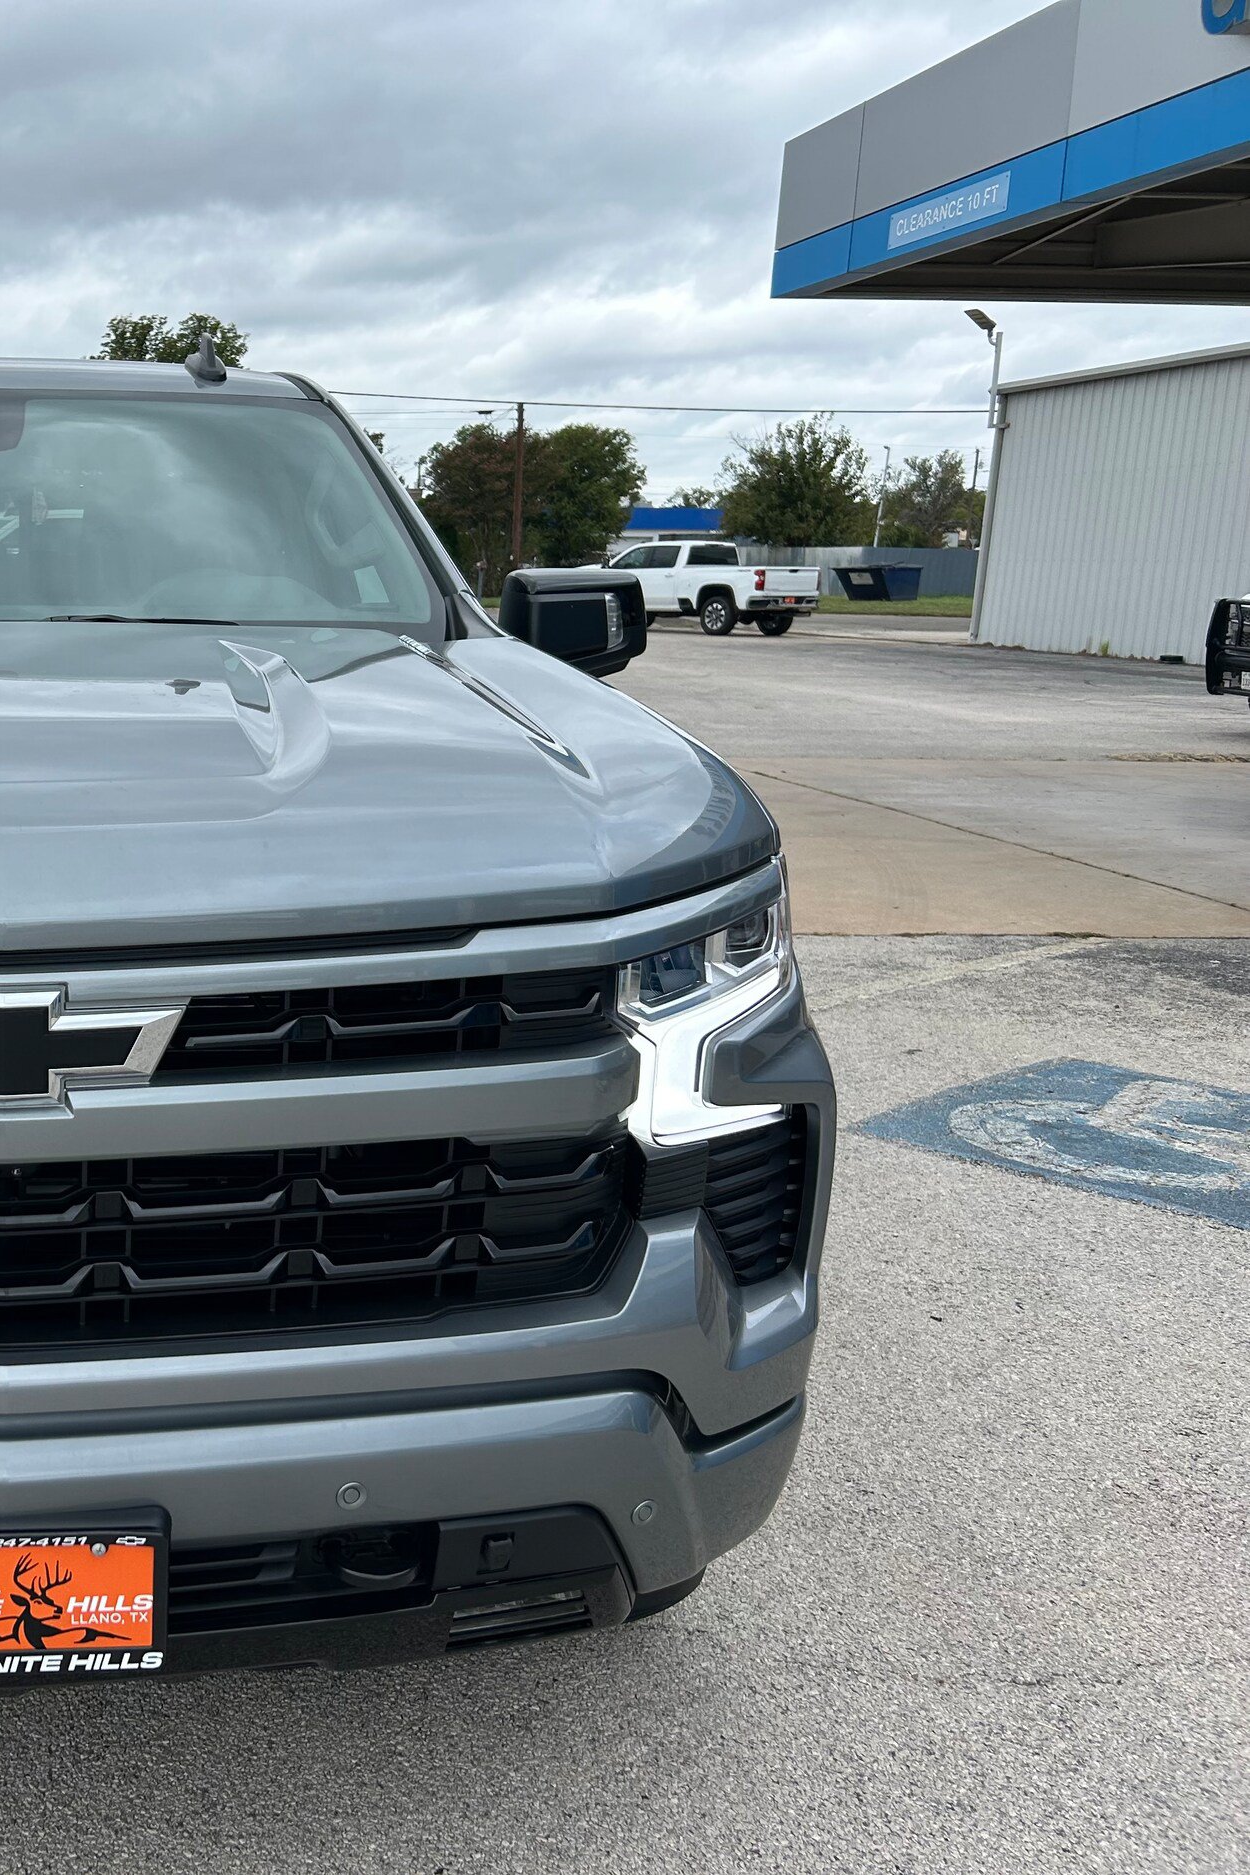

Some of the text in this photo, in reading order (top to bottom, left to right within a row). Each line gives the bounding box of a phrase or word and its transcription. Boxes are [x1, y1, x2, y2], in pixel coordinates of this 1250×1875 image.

[896, 184, 999, 236] CLEARANCE 10 FT
[66, 1594, 154, 1614] HILLS
[71, 1611, 148, 1625] LLANO, TX
[68, 1651, 163, 1671] HILLS
